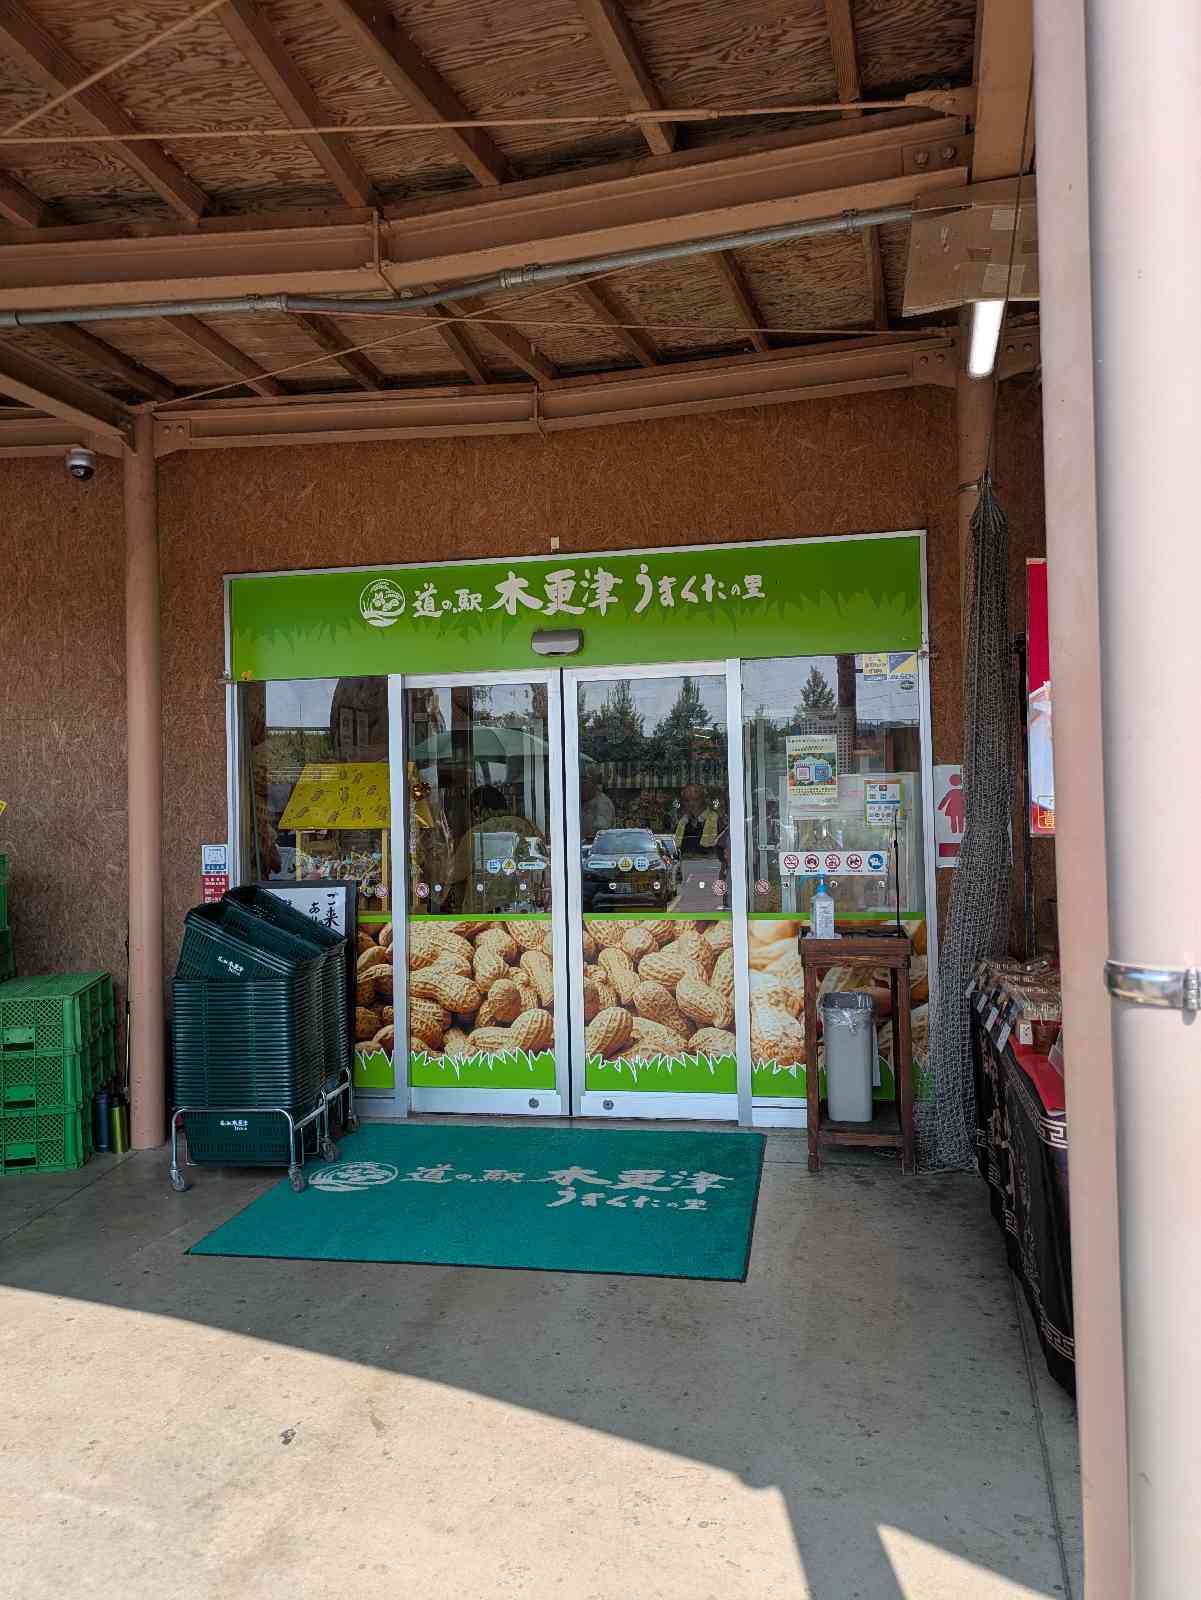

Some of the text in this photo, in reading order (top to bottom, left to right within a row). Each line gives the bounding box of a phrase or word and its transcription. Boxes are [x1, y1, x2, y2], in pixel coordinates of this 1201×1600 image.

[412, 563, 766, 618] 道の駅 木更津 うまくたの里
[400, 1164, 735, 1211] 道の駅 木更津 うまくたの里
